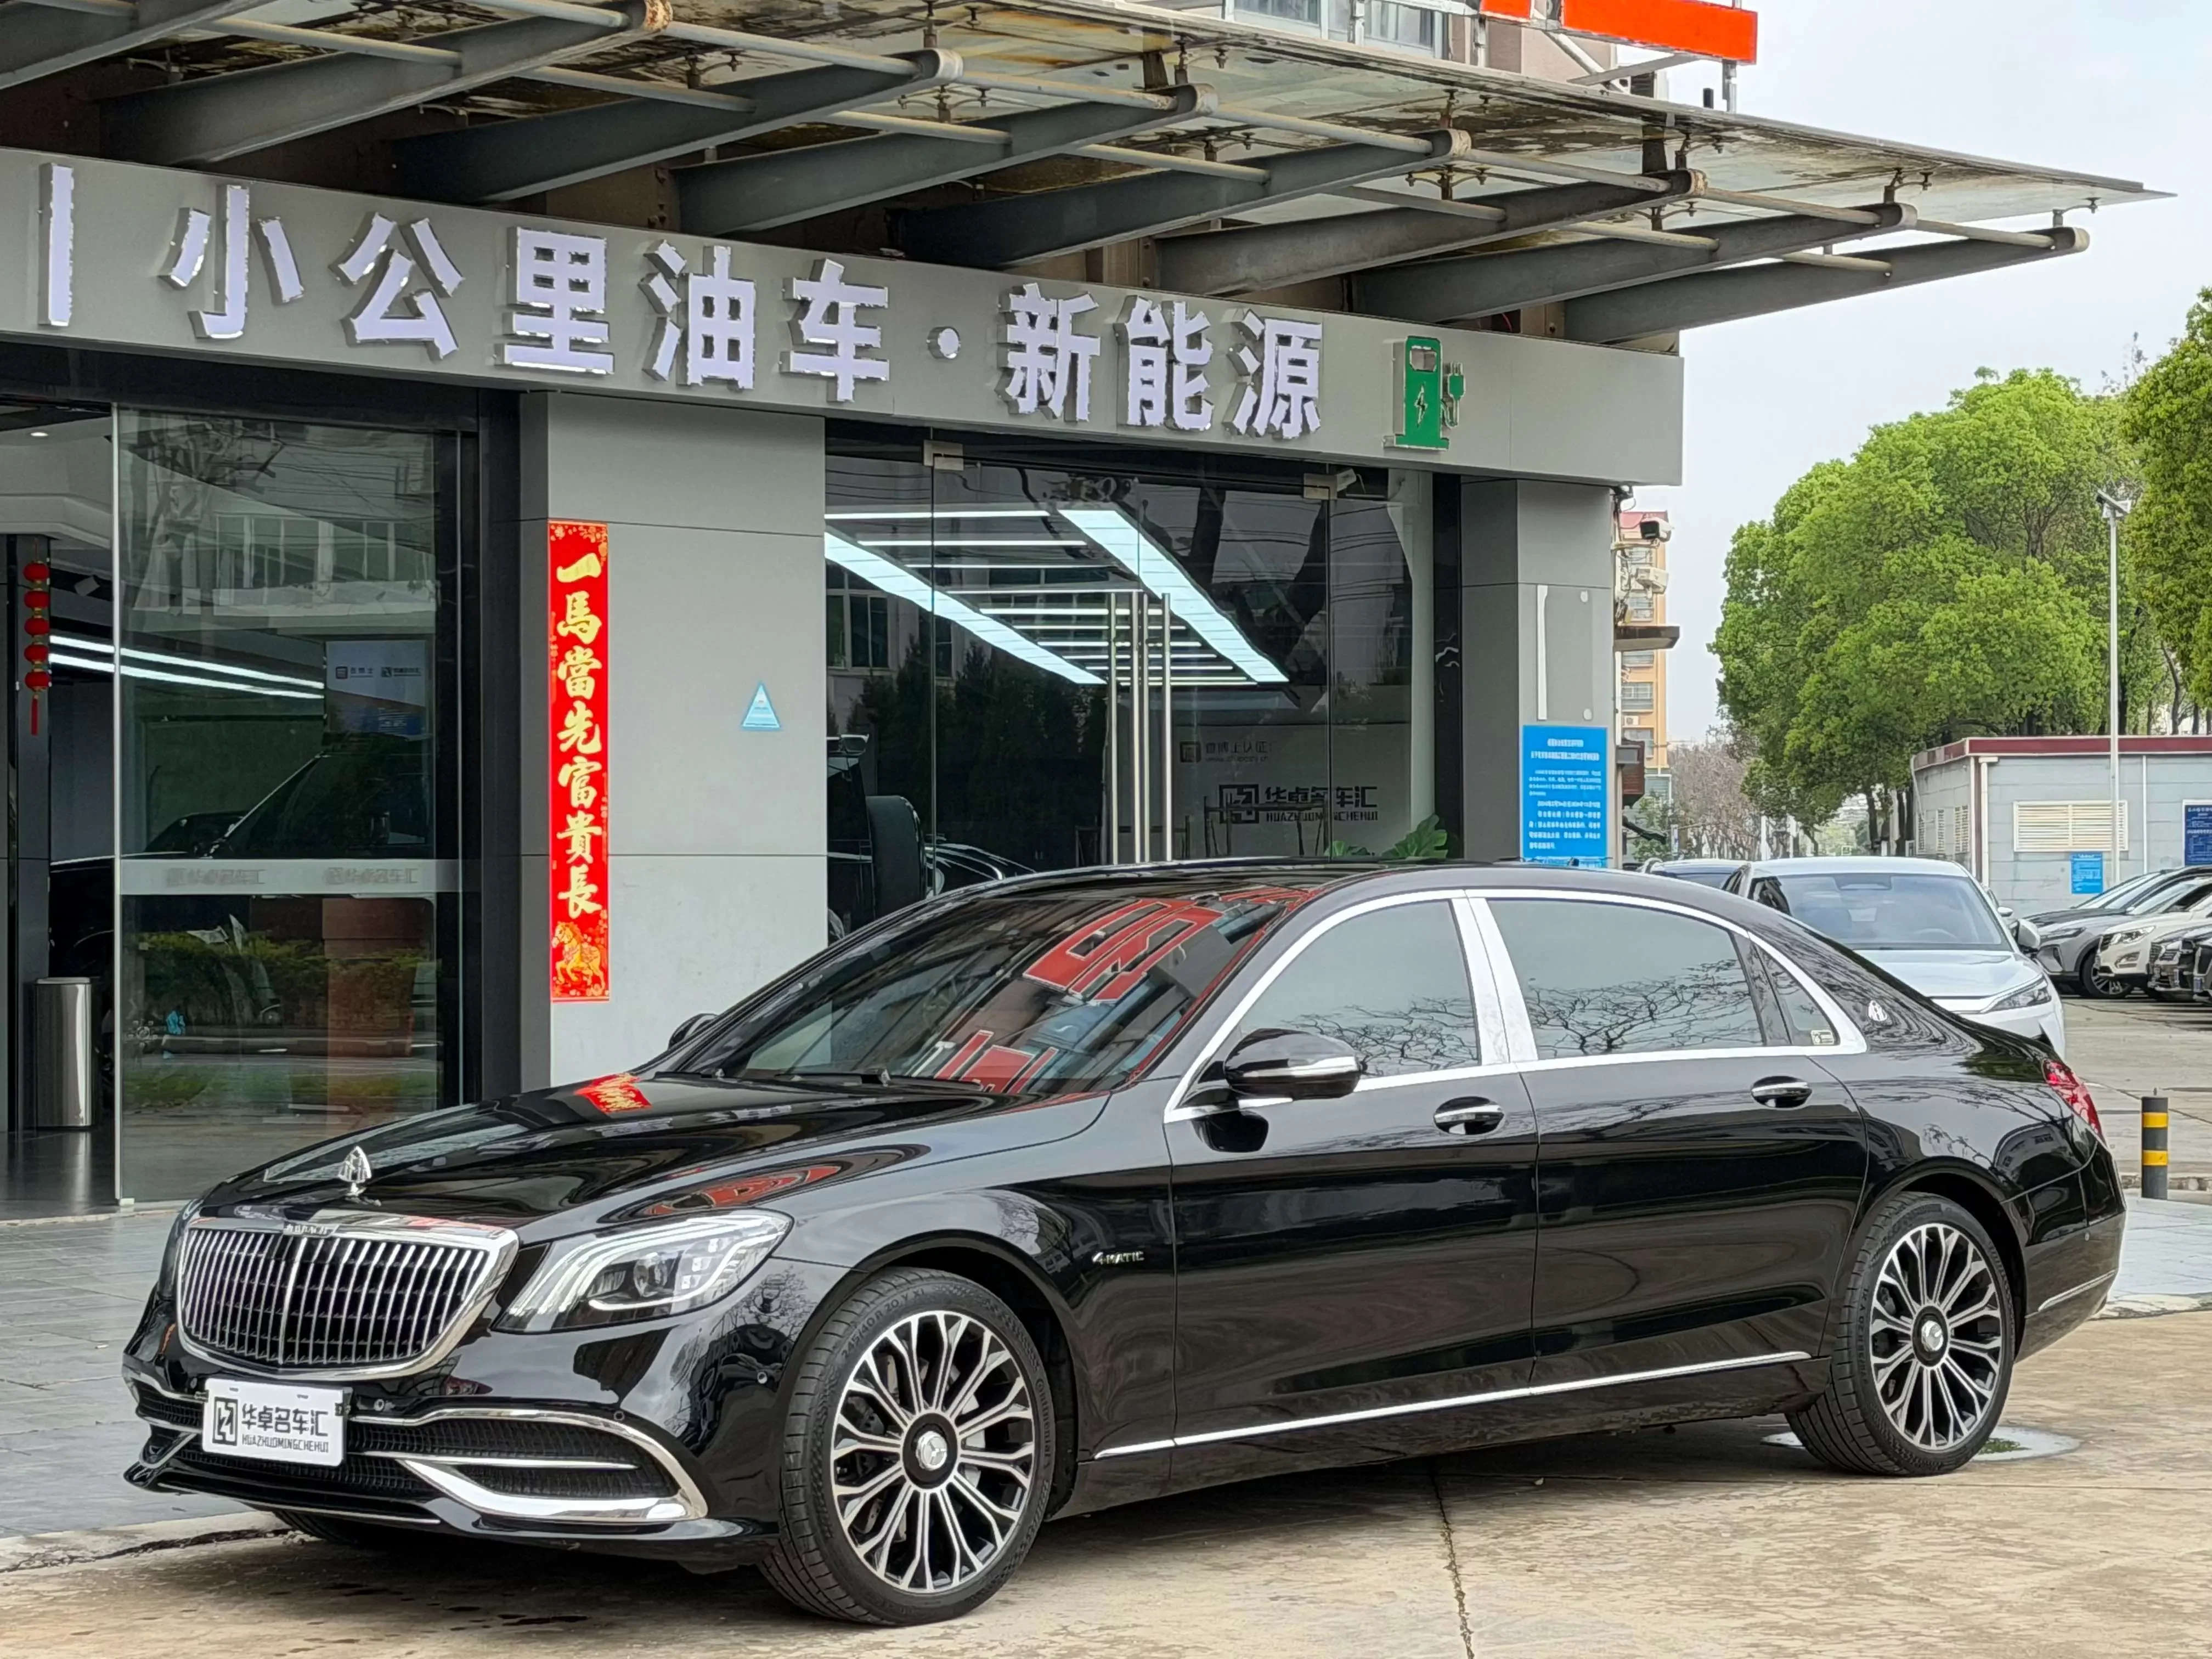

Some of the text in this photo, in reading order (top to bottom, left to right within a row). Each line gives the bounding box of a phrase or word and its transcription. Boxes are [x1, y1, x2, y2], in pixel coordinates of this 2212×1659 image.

[556, 552, 602, 919] 一馬當先富貴長
[241, 1402, 329, 1437] 华卓名车汇
[241, 1434, 330, 1453] HUAZHUOMINGCHEHUI
